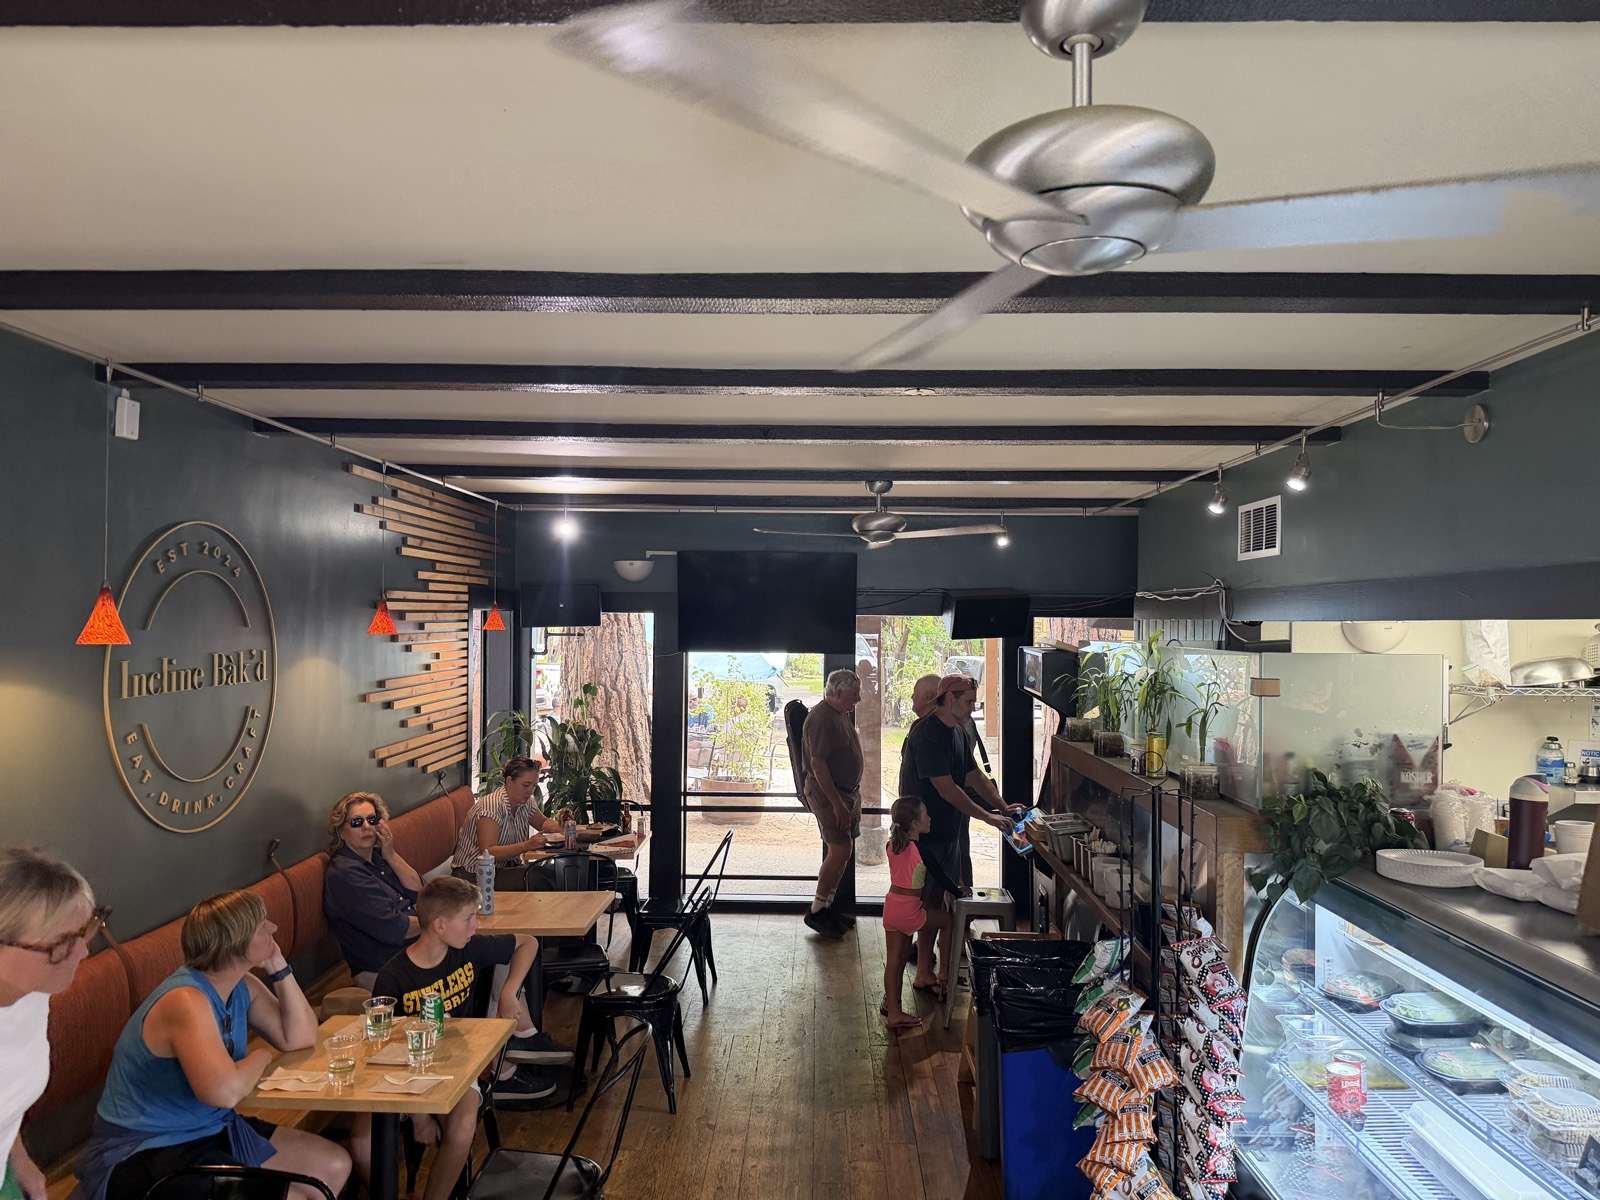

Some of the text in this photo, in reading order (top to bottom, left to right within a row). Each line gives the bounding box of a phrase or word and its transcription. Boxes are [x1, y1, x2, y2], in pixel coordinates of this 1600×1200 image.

[157, 541, 241, 577] EST 2024
[120, 657, 205, 699] Incline
[224, 709, 261, 789] CRAFT
[1401, 771, 1432, 784] KOSHER
